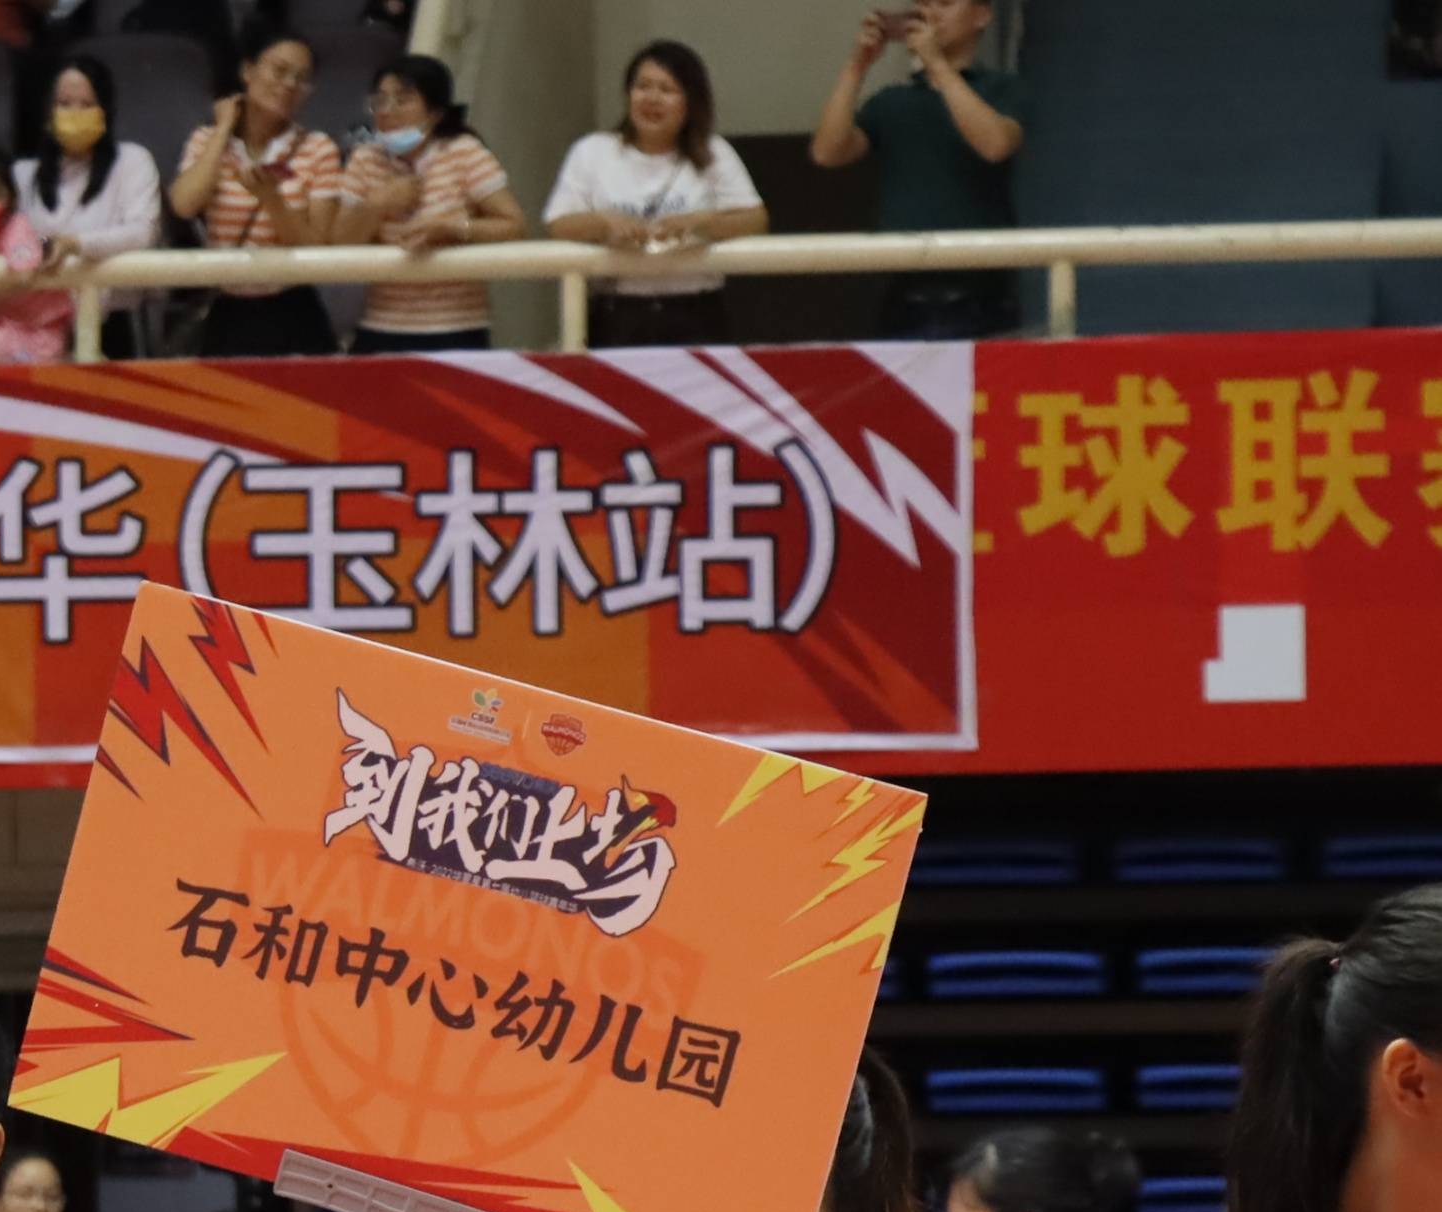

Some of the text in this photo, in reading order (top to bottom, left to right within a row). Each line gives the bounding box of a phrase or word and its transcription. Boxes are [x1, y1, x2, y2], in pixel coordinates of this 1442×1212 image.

[973, 370, 1442, 557] 球联
[323, 687, 676, 937] 到我们上场
[165, 878, 741, 1108] 石和中心幼儿园
